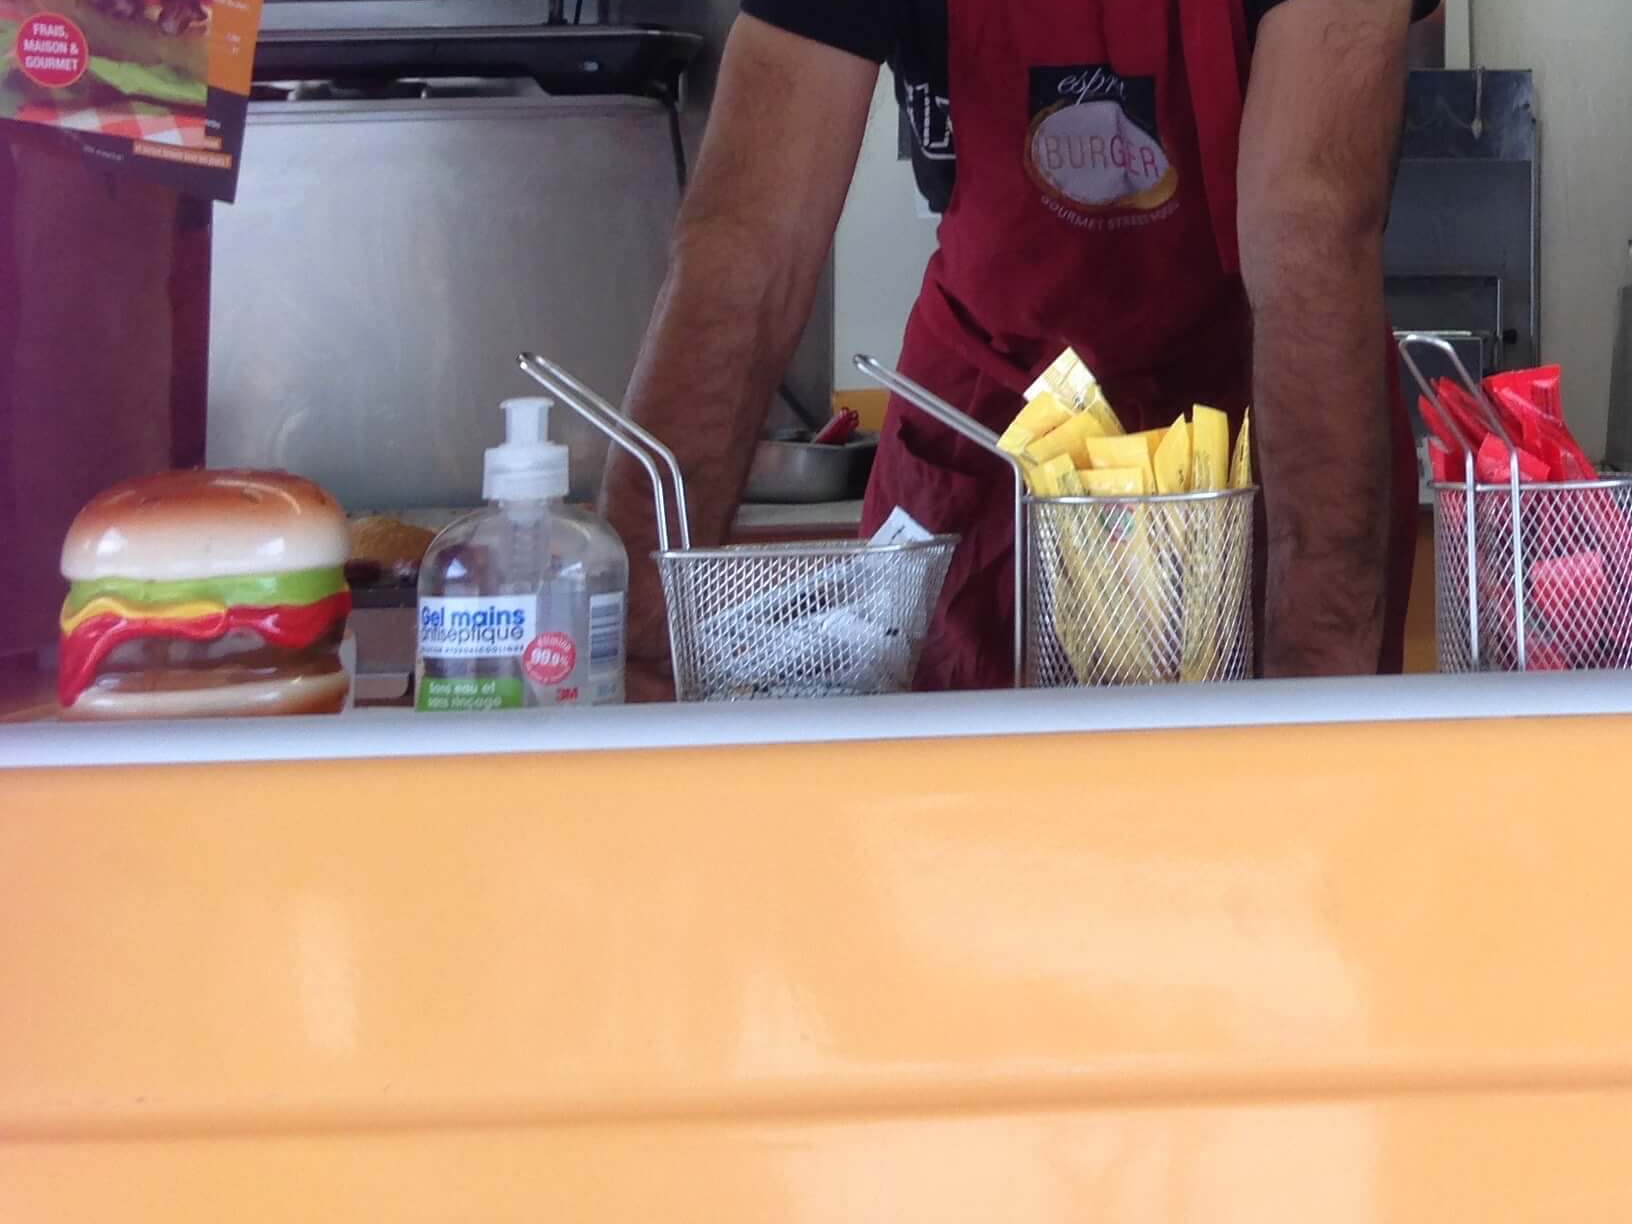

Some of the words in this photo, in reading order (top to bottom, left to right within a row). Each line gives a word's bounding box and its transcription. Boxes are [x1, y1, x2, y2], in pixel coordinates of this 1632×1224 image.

[23, 39, 67, 54] MAISON
[25, 56, 78, 71] GOURMET
[1044, 134, 1160, 178] BURGER
[421, 605, 445, 627] Gel
[450, 605, 526, 627] mains
